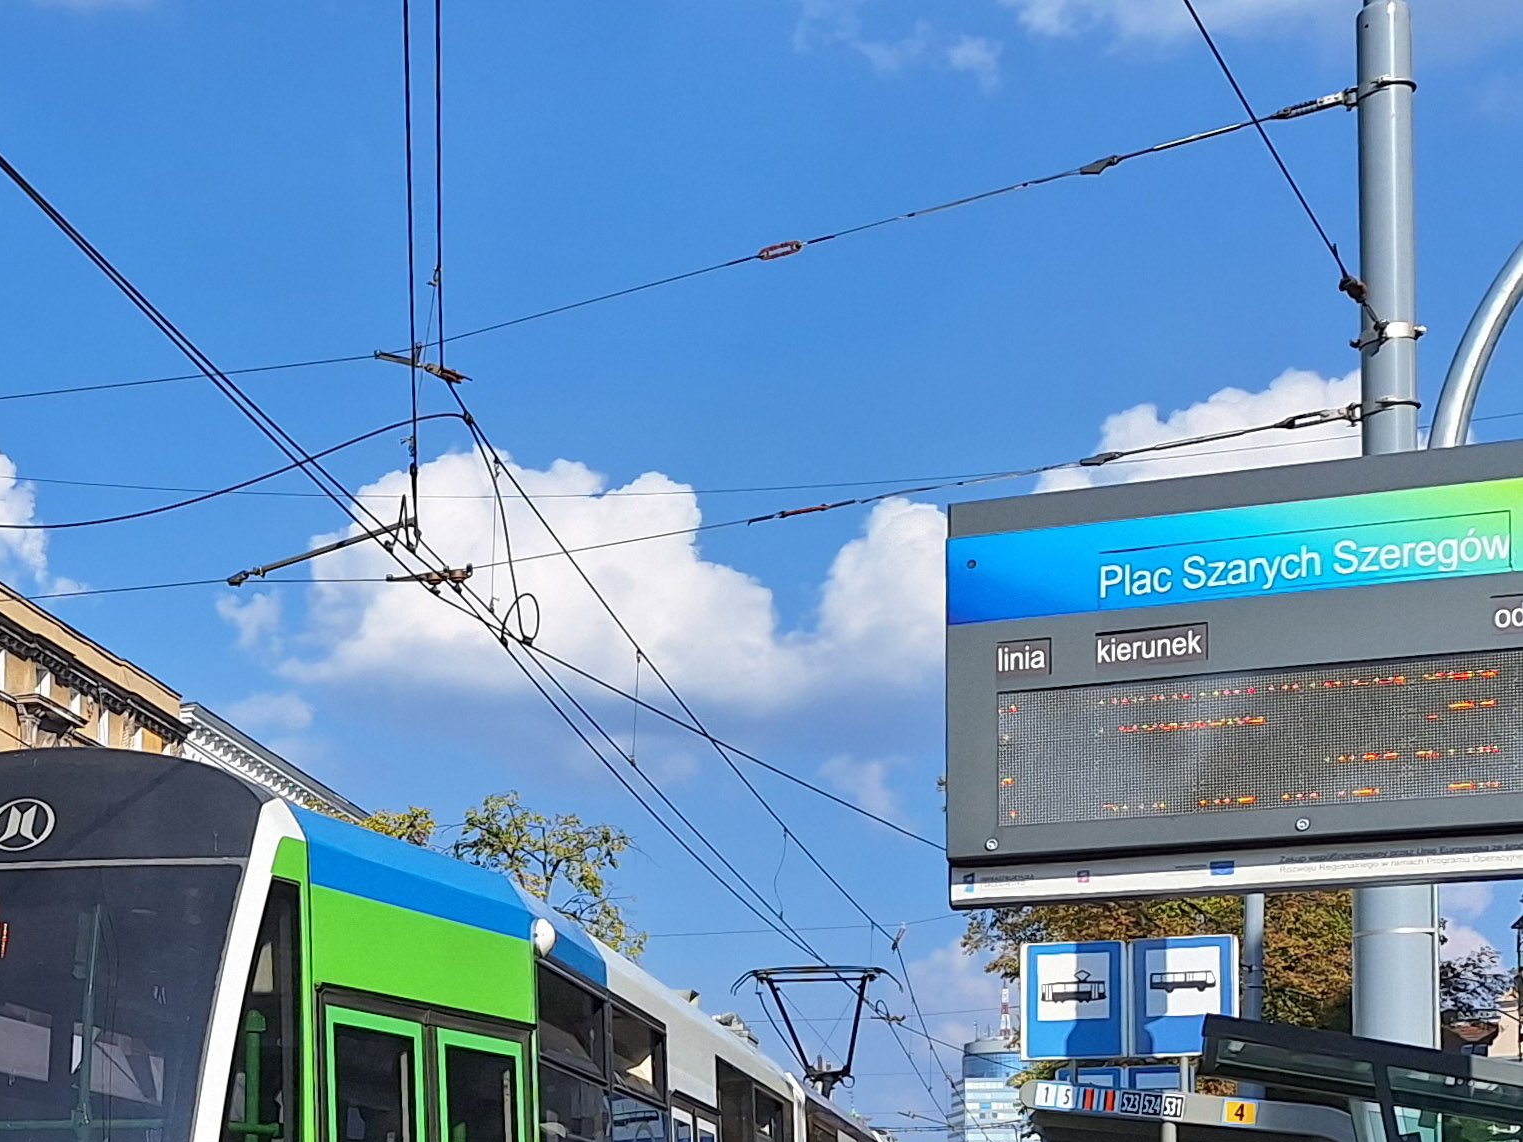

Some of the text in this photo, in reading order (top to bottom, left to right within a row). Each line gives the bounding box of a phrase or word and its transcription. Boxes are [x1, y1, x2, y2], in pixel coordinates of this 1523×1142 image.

[1099, 527, 1511, 599] Plac Szarych Szeregów
[1096, 629, 1202, 664] kierunek
[997, 644, 1046, 672] linia
[1043, 1086, 1050, 1104] 1
[1062, 1088, 1071, 1105] 5
[1121, 1095, 1139, 1113] 523
[1142, 1096, 1161, 1115] 524
[1163, 1096, 1182, 1118] 531
[1234, 1103, 1246, 1121] 4
